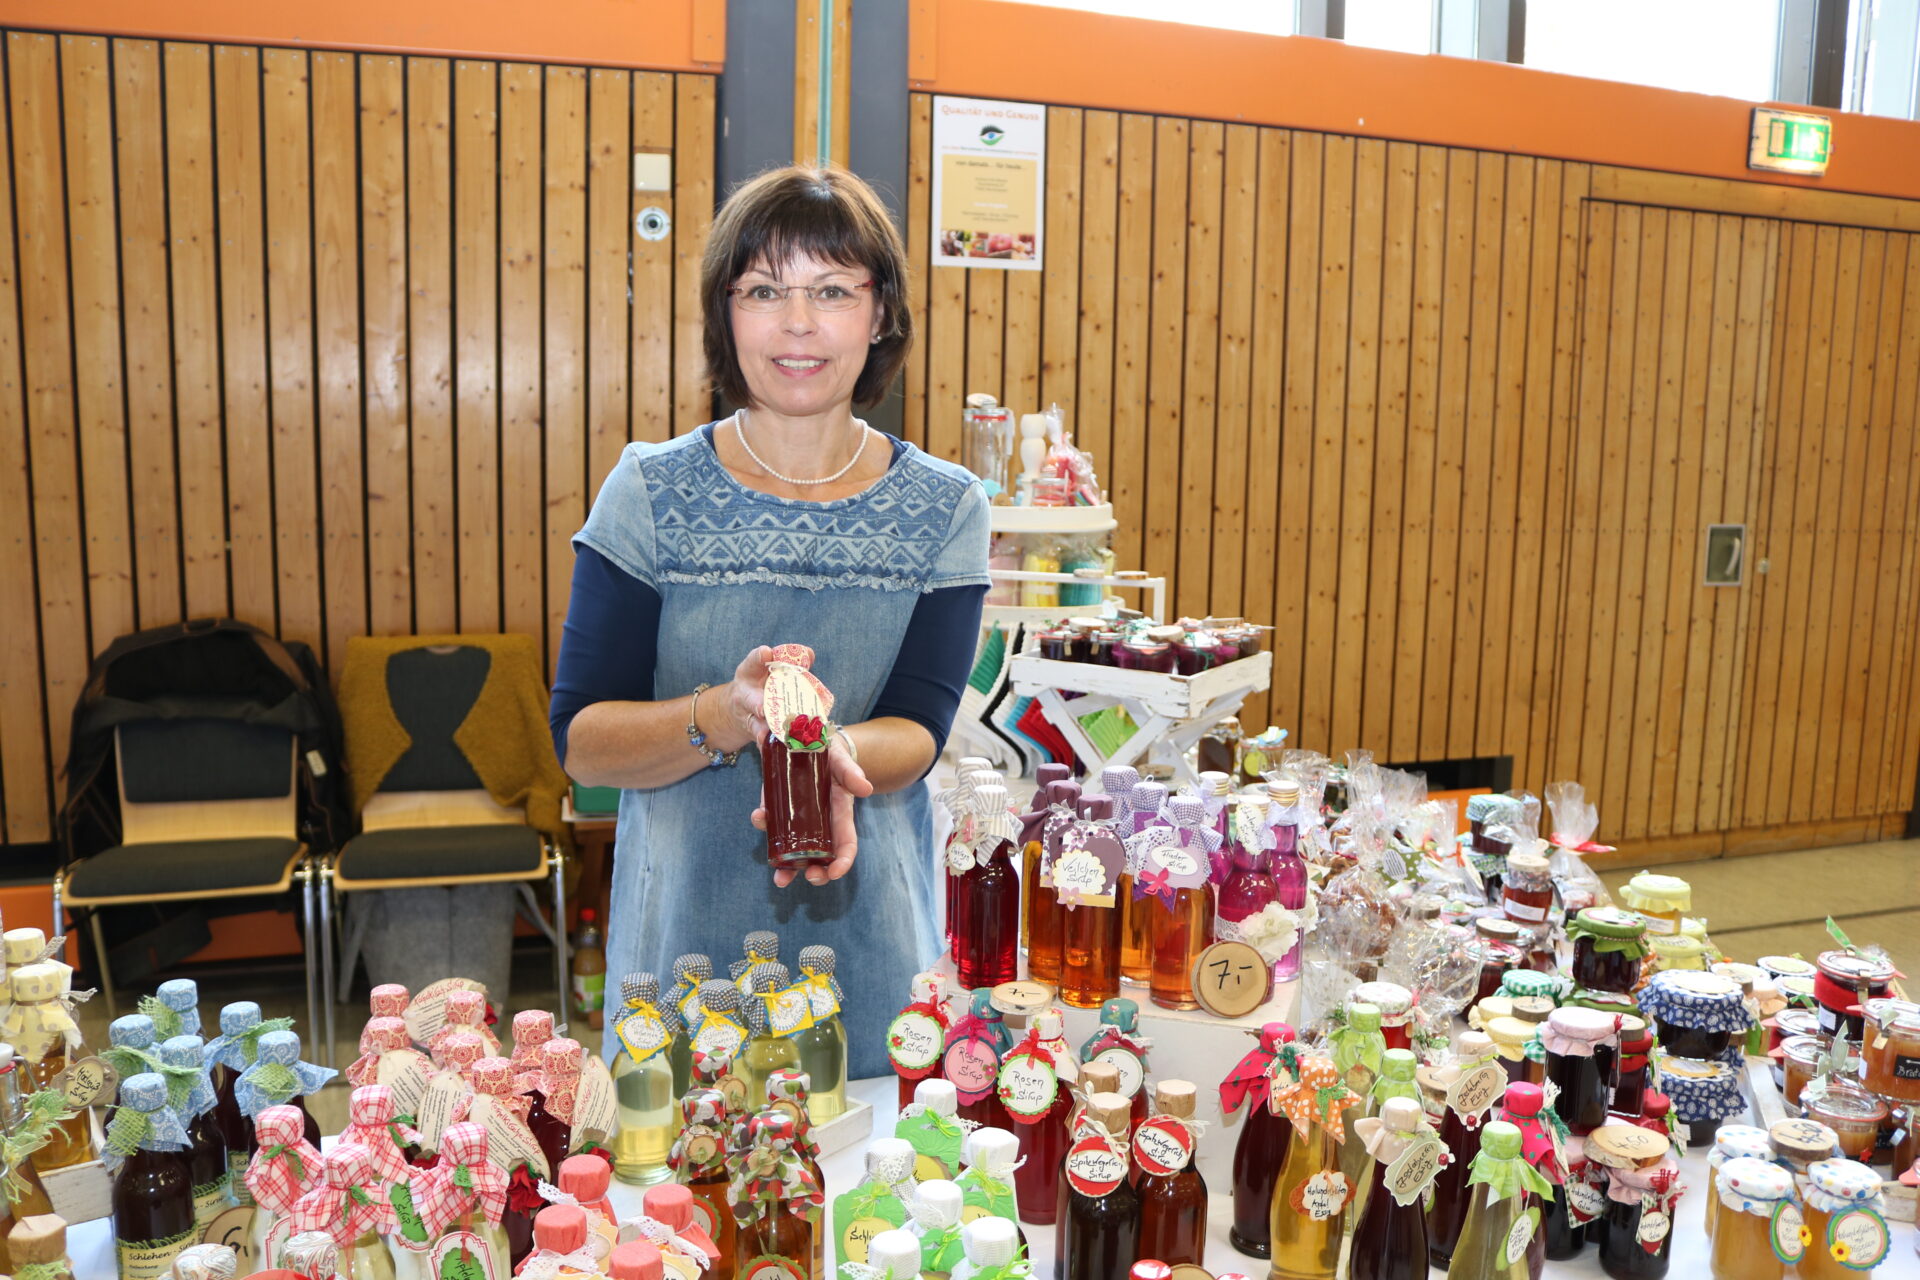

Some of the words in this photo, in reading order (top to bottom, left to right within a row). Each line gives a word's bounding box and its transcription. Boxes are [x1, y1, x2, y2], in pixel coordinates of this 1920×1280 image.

[1063, 857, 1099, 878] Veilchen
[1166, 860, 1187, 872] Sirup
[1066, 871, 1092, 887] Sirup
[903, 1022, 932, 1044] Rosen
[902, 1041, 929, 1059] Sirup
[958, 1046, 983, 1066] Rosen
[958, 1064, 983, 1085] Sirup
[1012, 1070, 1044, 1088] Rosen
[1016, 1089, 1043, 1106] Sirup
[1088, 1167, 1112, 1181] Sirup
[128, 1250, 172, 1261] Schlehen
